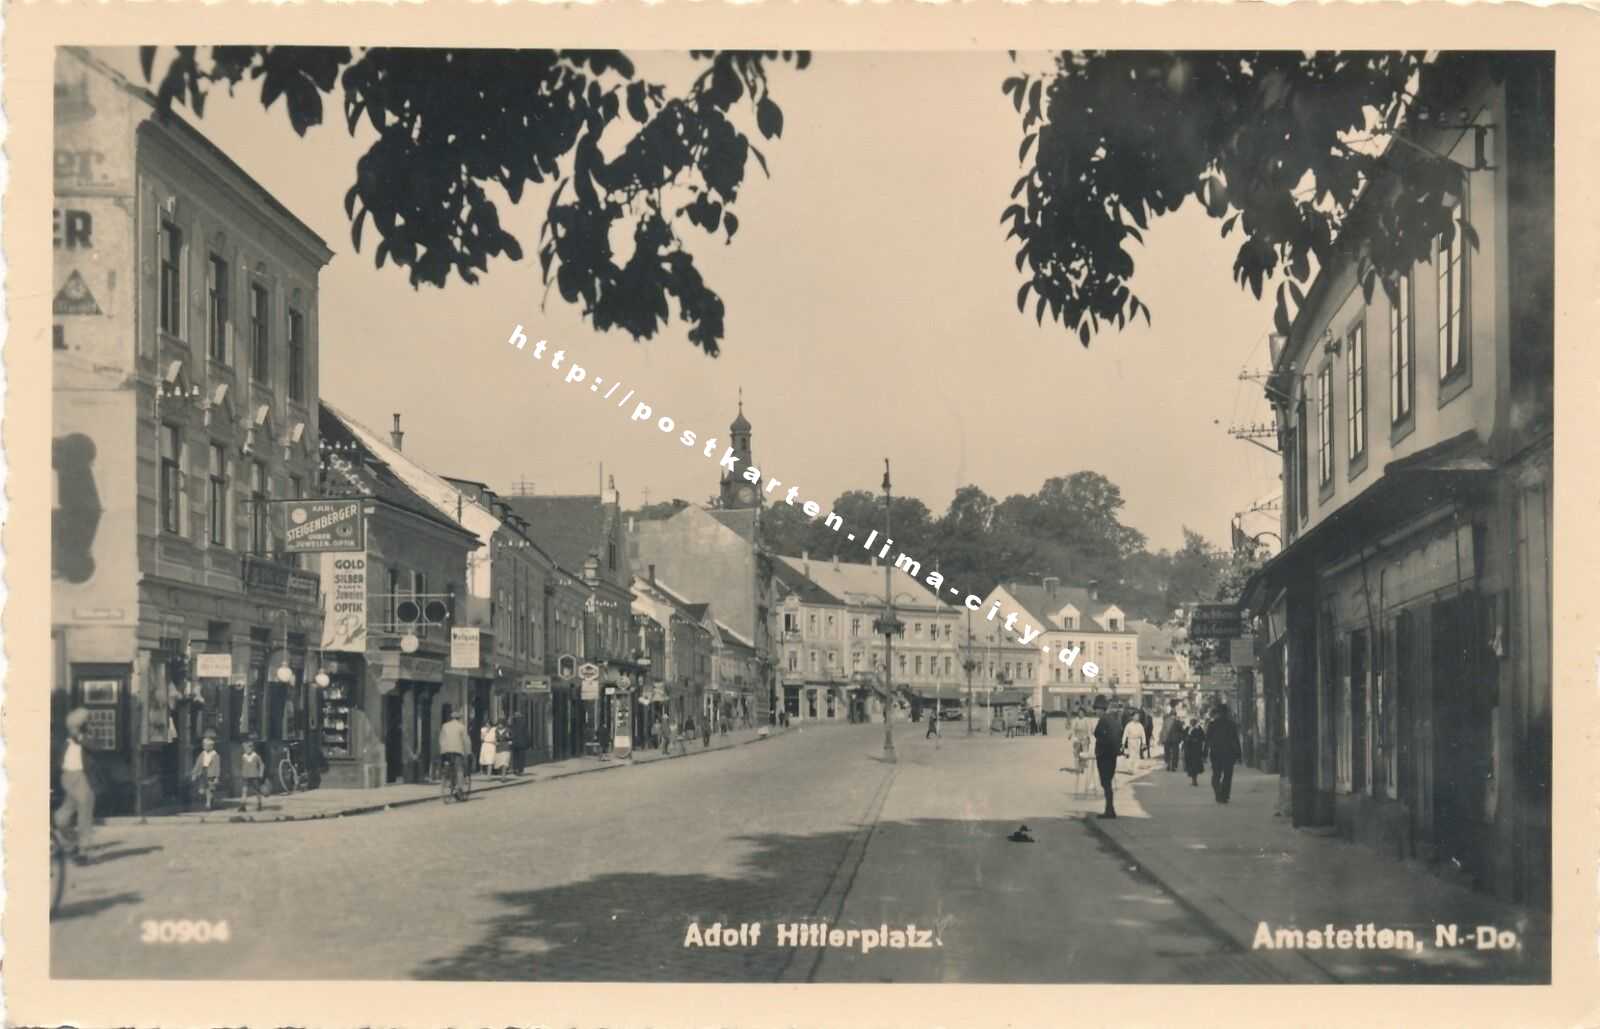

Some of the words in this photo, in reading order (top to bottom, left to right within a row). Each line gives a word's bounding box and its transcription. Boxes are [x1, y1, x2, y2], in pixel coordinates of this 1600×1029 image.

[287, 503, 357, 542] STEIGENBERGER
[335, 559, 365, 570] GOLD
[335, 574, 364, 584] SILBER
[334, 602, 363, 613] OPTIK
